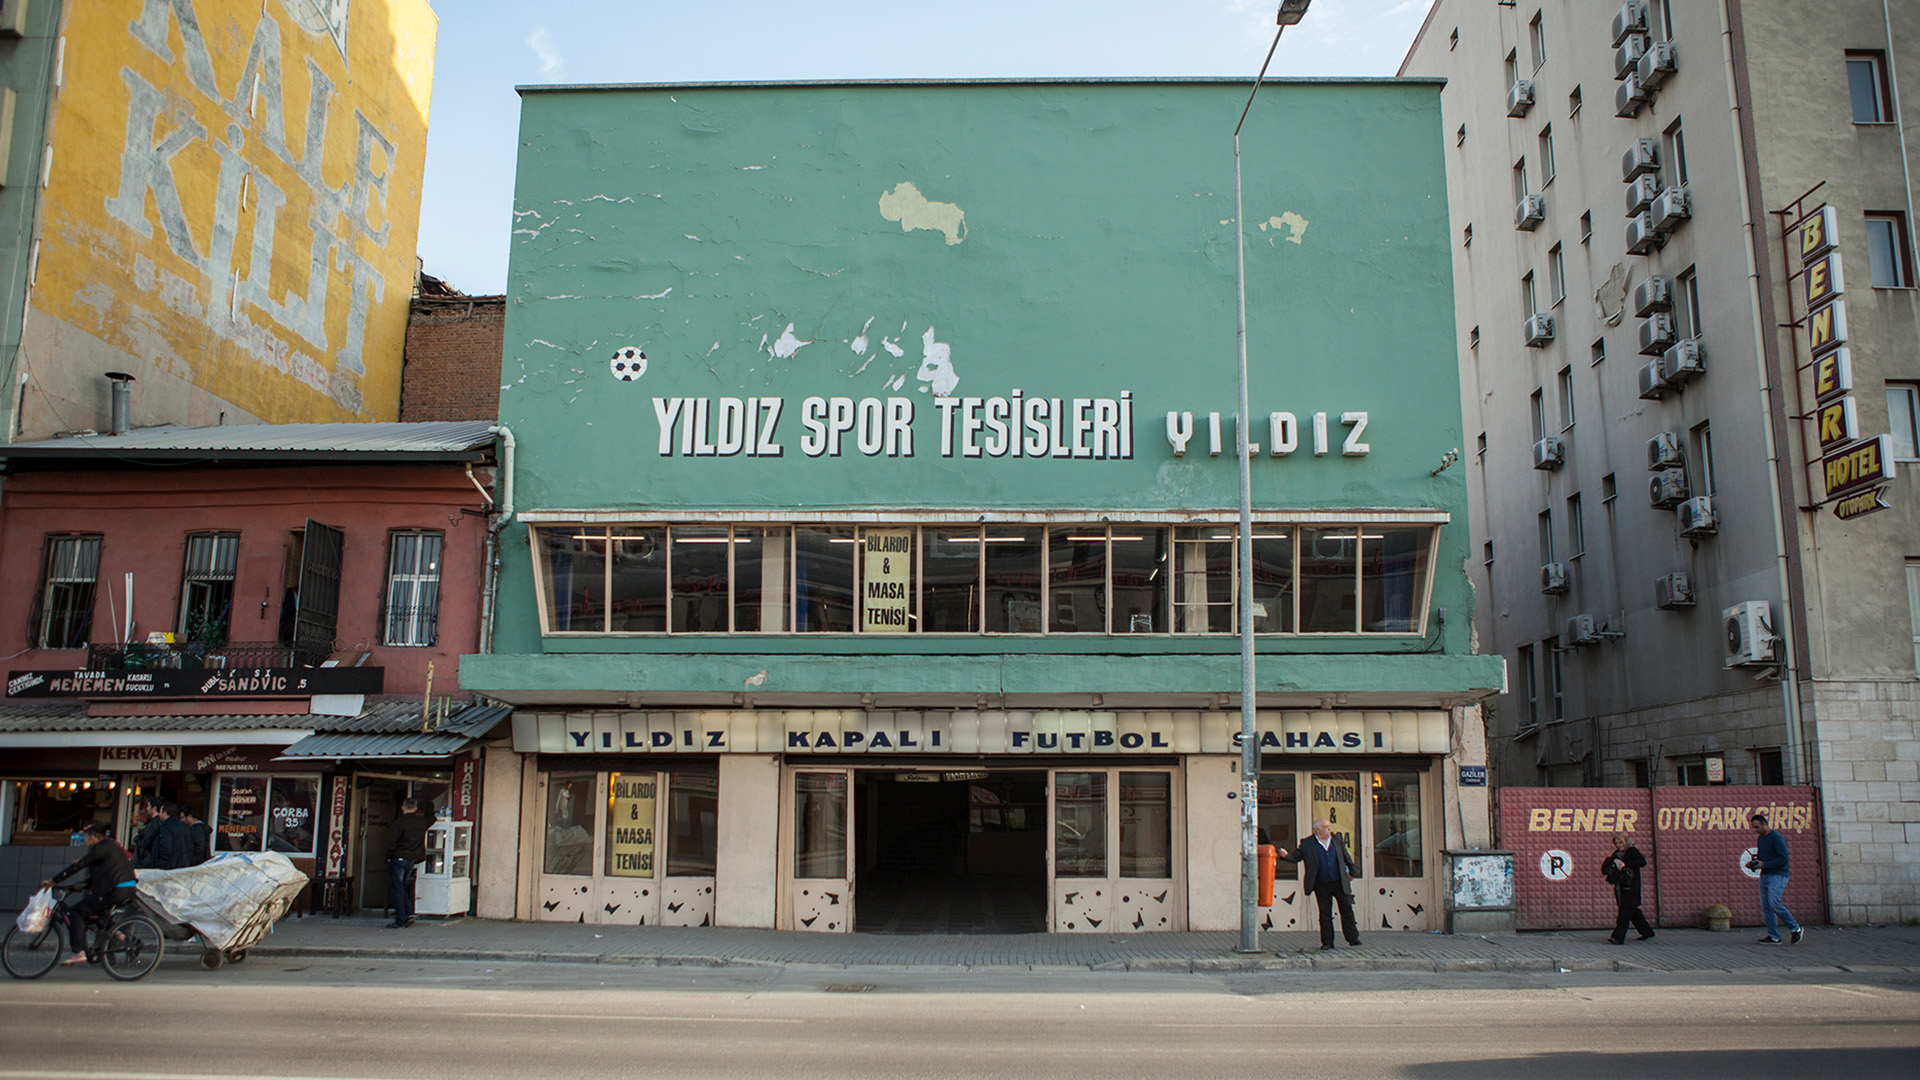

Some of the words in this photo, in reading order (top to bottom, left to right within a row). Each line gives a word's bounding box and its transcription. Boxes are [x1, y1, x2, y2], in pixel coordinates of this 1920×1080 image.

[1802, 213, 1843, 442] BENER
[652, 396, 784, 458] YILDIZ
[800, 396, 915, 458] SPOR
[934, 388, 1134, 460] TESİSLERİ
[1826, 444, 1880, 494] HOTEL
[1839, 491, 1877, 518] OTOPARK
[867, 533, 909, 553] BİLARDO
[882, 557, 891, 574] &
[868, 582, 905, 599] MASA
[867, 606, 906, 626] TENİSİ
[50, 678, 126, 692] MENEMEN
[569, 730, 727, 748] YILDIZ
[788, 730, 942, 748] KAPALI
[1011, 730, 1169, 748] FUTBOL
[102, 747, 178, 761] KERVAN
[141, 759, 173, 770] BÜFE
[616, 779, 655, 799] BİLARDO
[1313, 782, 1354, 803] BİLARDO
[273, 807, 309, 818] ÇORBA
[630, 803, 639, 820] &
[1329, 807, 1337, 824] &
[1528, 808, 1639, 832] BENER
[1657, 806, 1751, 830] OTOPARK
[218, 824, 258, 834] MENEMEN
[615, 828, 652, 845] MASA
[615, 851, 653, 871] TENİSİ
[1551, 856, 1564, 875] P
